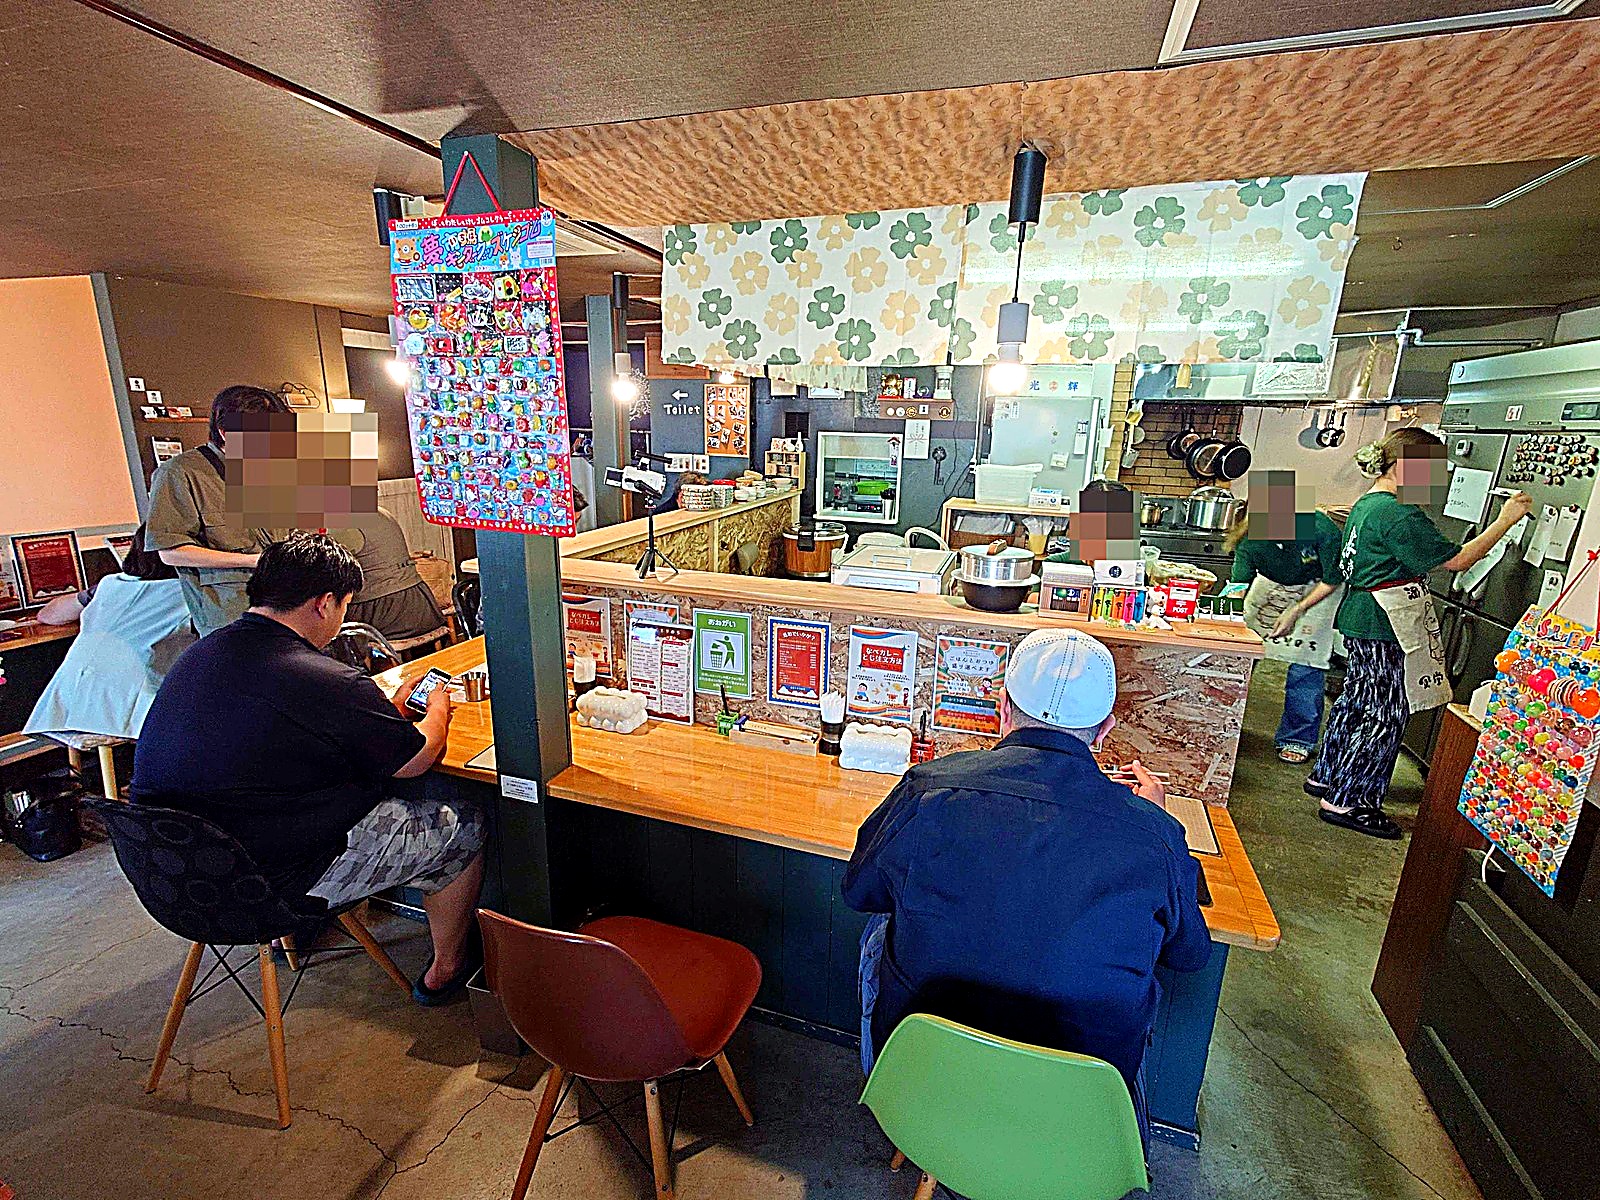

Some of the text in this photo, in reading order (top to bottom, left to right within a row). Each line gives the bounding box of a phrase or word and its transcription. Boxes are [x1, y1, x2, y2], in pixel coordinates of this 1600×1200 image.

[663, 403, 701, 415] Toilet
[1172, 606, 1189, 614] POST
[865, 647, 900, 657] なべカレー
[862, 653, 903, 665] とじ注文方法
